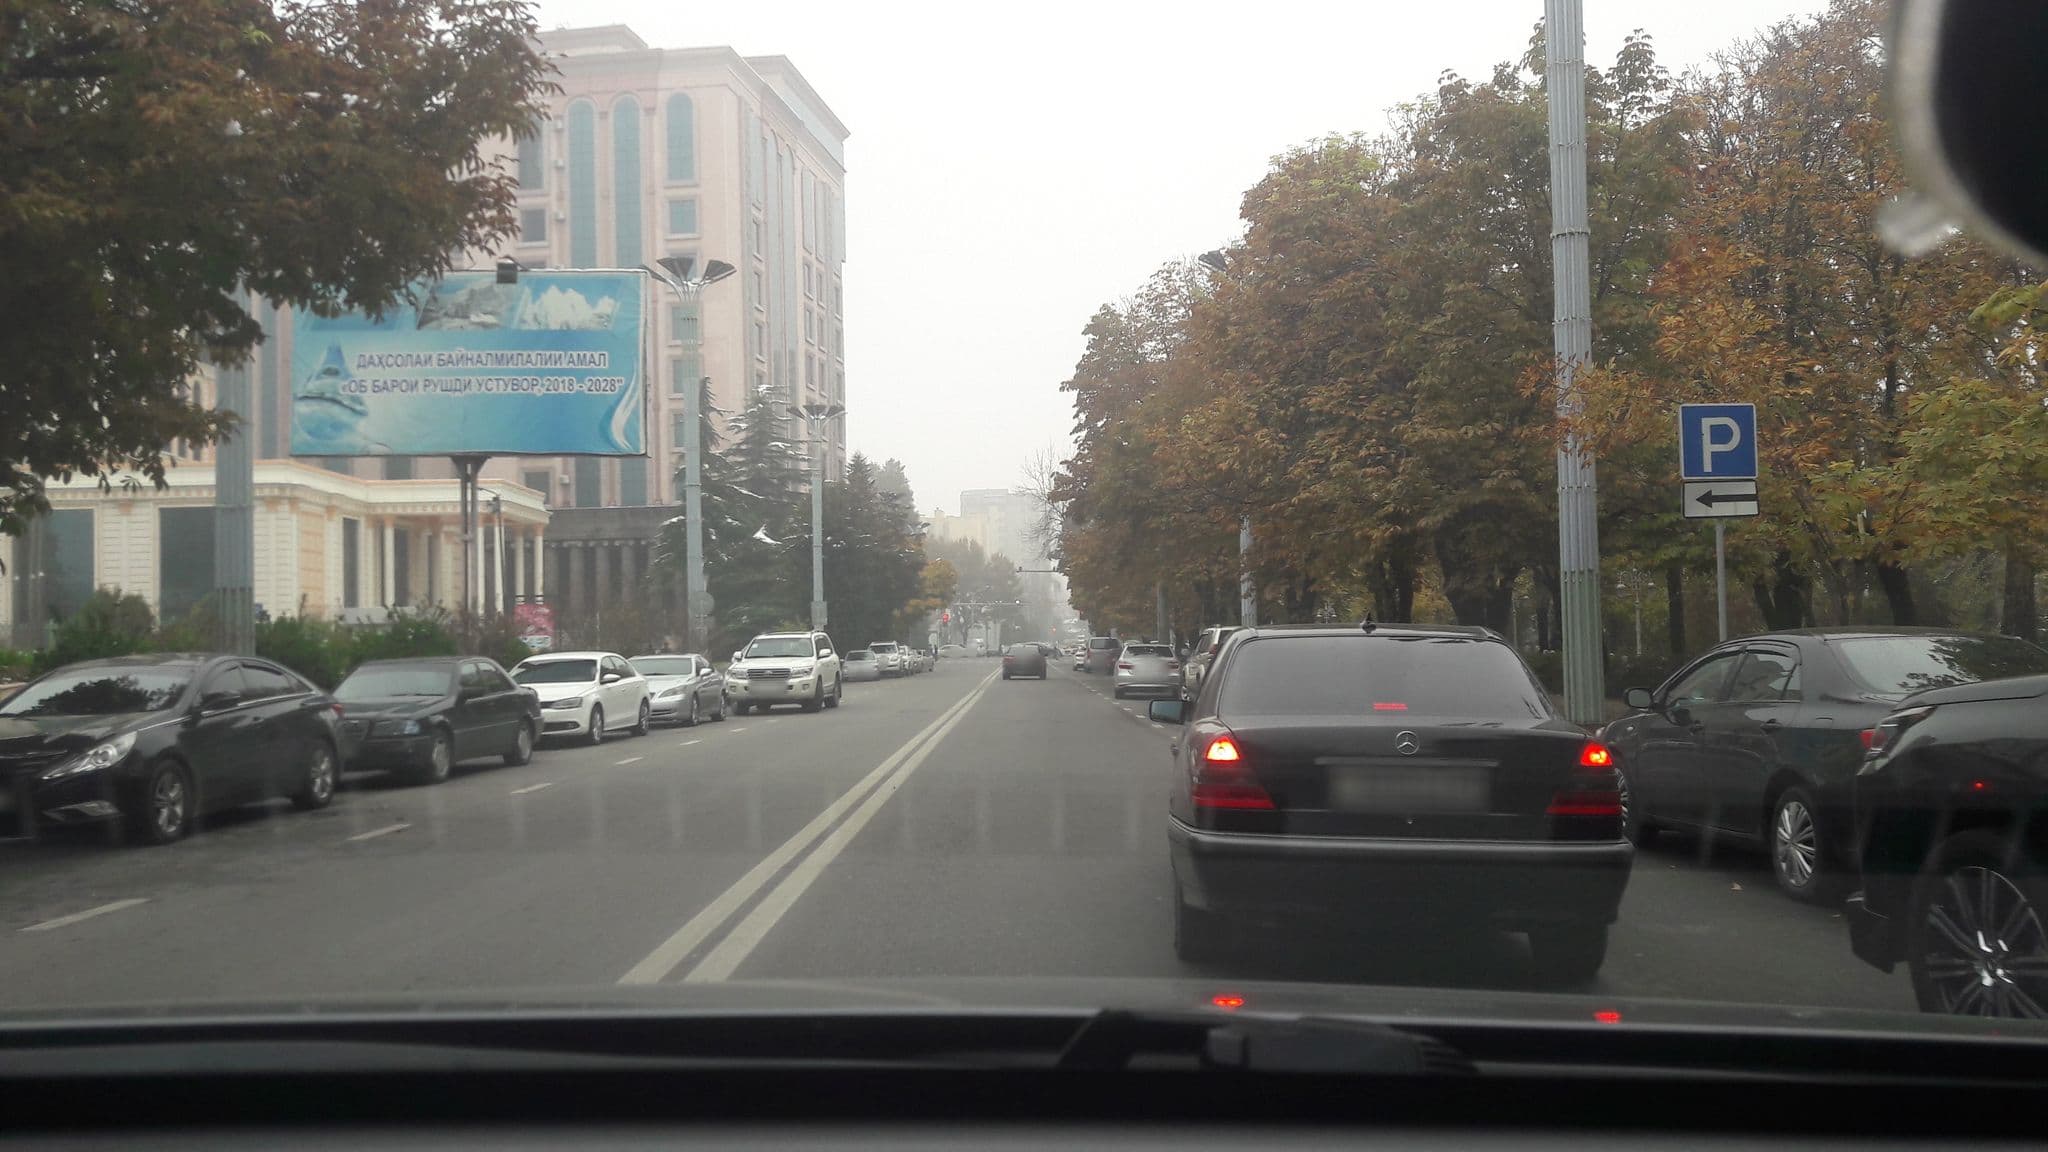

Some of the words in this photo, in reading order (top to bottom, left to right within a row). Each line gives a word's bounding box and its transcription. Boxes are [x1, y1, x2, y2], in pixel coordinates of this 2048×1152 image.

[566, 352, 608, 367] АМАЛ
[371, 379, 420, 394] БАРОИ
[422, 377, 473, 395] РУШДИ
[544, 378, 576, 393] 2018
[1701, 416, 1741, 473] P
